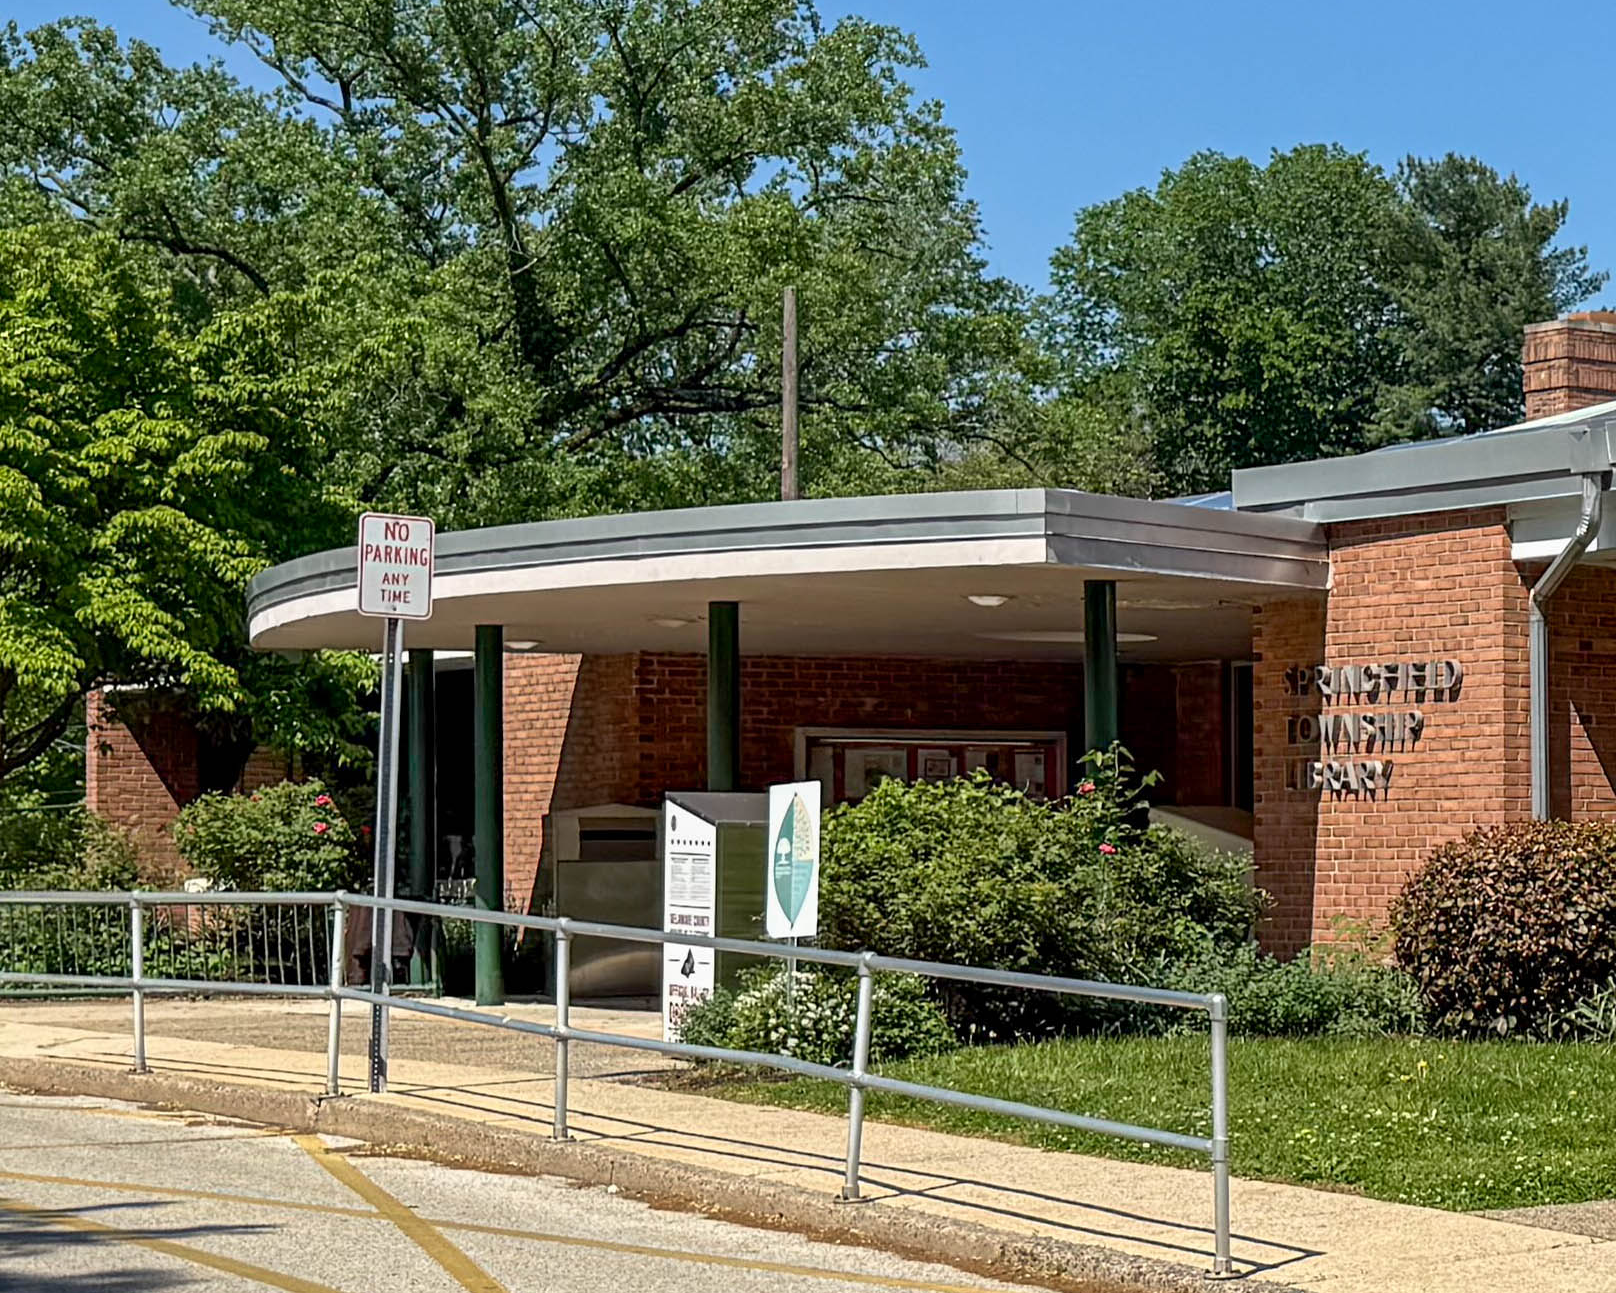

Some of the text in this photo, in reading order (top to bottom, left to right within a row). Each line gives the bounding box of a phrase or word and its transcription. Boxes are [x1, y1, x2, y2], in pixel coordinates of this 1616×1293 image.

[384, 522, 409, 542] NO
[365, 544, 428, 566] PARKING
[382, 572, 409, 586] ANY
[380, 589, 410, 604] TIME
[1284, 660, 1463, 697] SPRINGFIELD
[1286, 711, 1424, 745] TOWNSHIP
